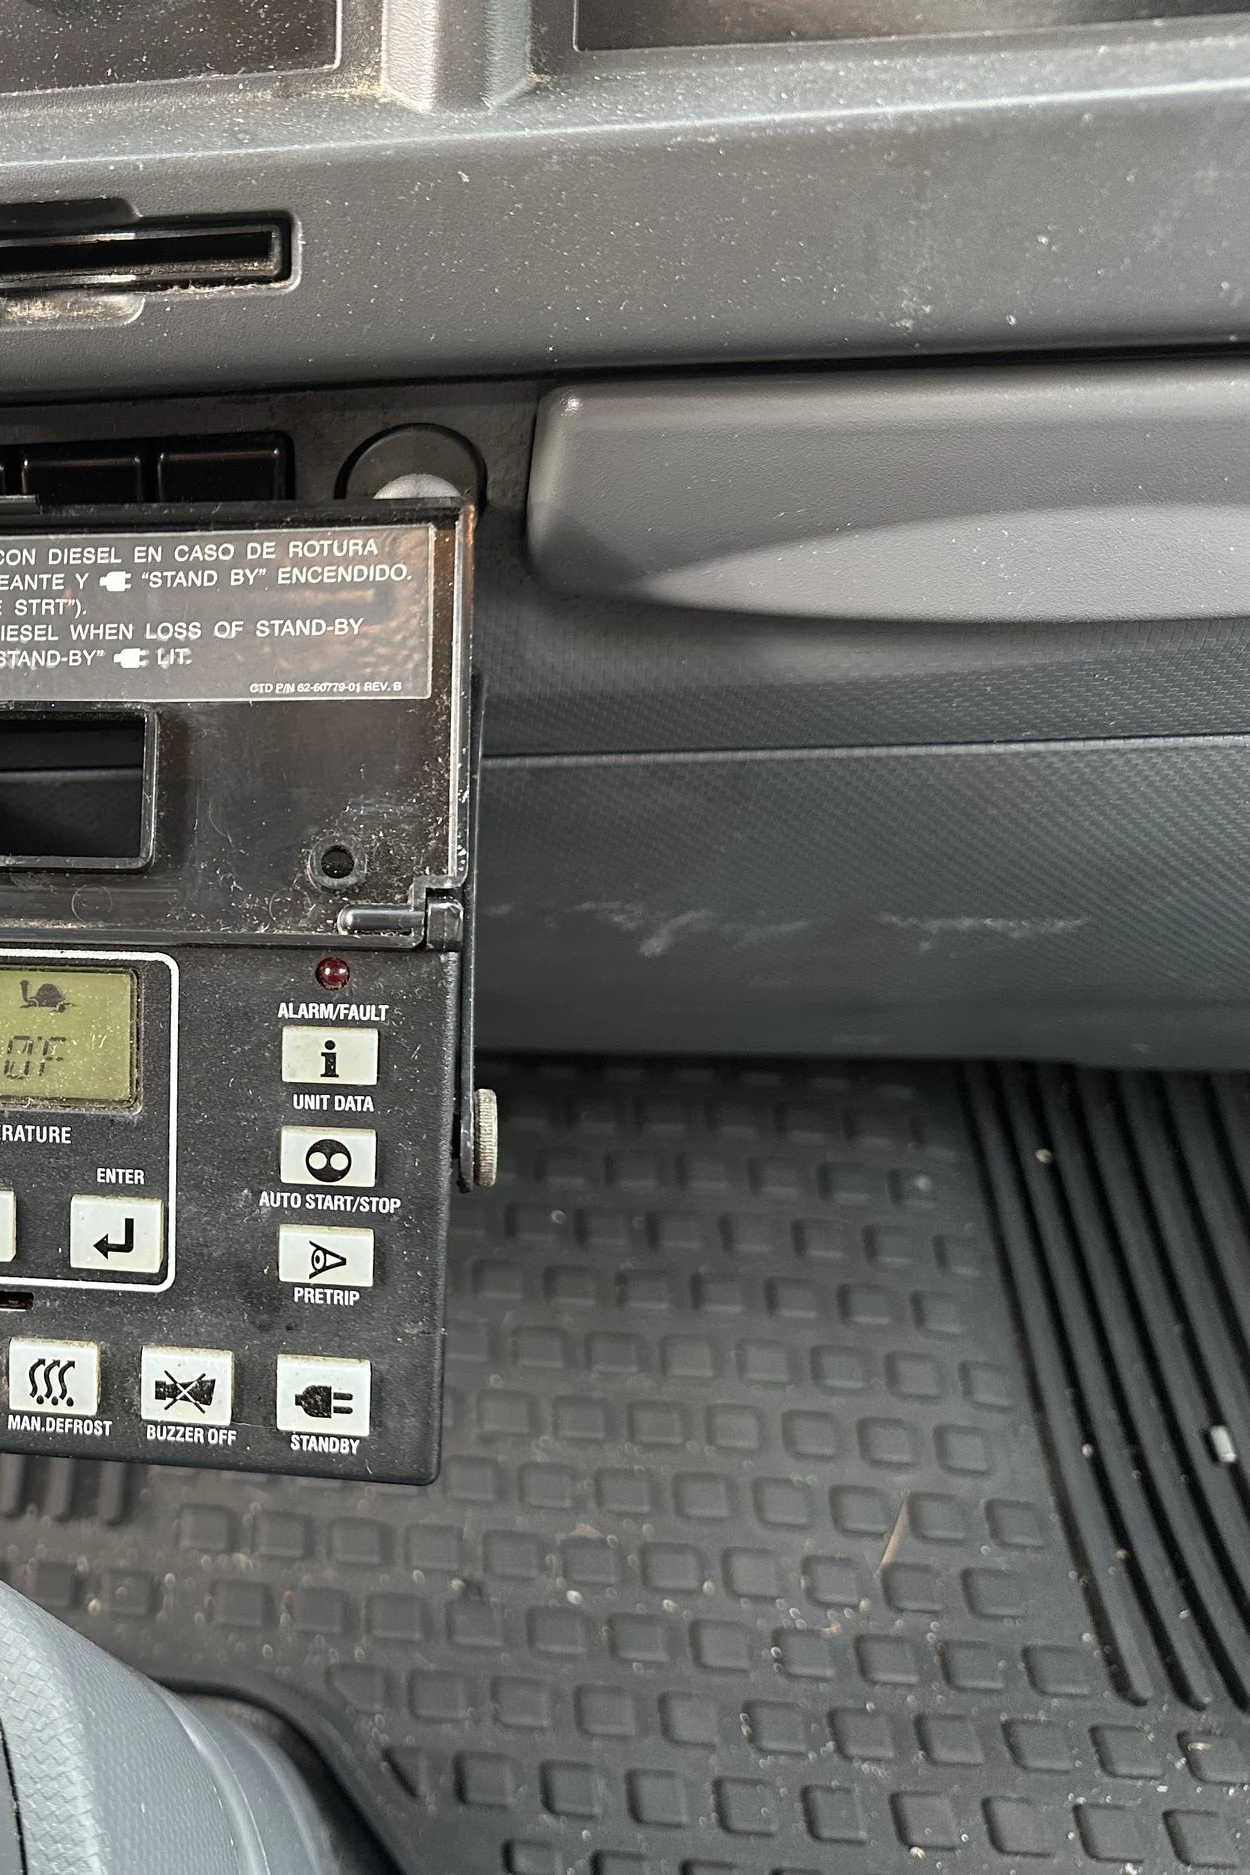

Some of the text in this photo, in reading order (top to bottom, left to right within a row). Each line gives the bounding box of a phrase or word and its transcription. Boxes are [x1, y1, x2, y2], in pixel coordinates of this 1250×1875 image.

[48, 547, 122, 565] DIESEL
[134, 546, 162, 563] EN
[174, 543, 235, 561] CASO
[248, 542, 276, 560] DE
[288, 538, 378, 558] ROTURA
[75, 574, 88, 590] Y
[278, 563, 412, 584] ENCENDIDO.
[70, 624, 133, 641] WHEN
[146, 622, 202, 640] LOSS
[214, 620, 244, 639] OF
[255, 618, 363, 638] STAND-BY
[156, 648, 191, 665] LIT.
[275, 683, 295, 693] P/N
[364, 682, 390, 692] REV.
[393, 681, 402, 692] B
[277, 1002, 388, 1021] ALARM/FAULT
[293, 1094, 374, 1112] UNIT DATA
[96, 1167, 144, 1185] ENTER
[259, 1191, 401, 1214] AUTO START/STOP
[294, 1287, 360, 1306] PRETRIP
[7, 1415, 112, 1438] MAN.DEFROST
[146, 1424, 237, 1445] BUZZER OFF
[289, 1435, 360, 1455] STANDBY
